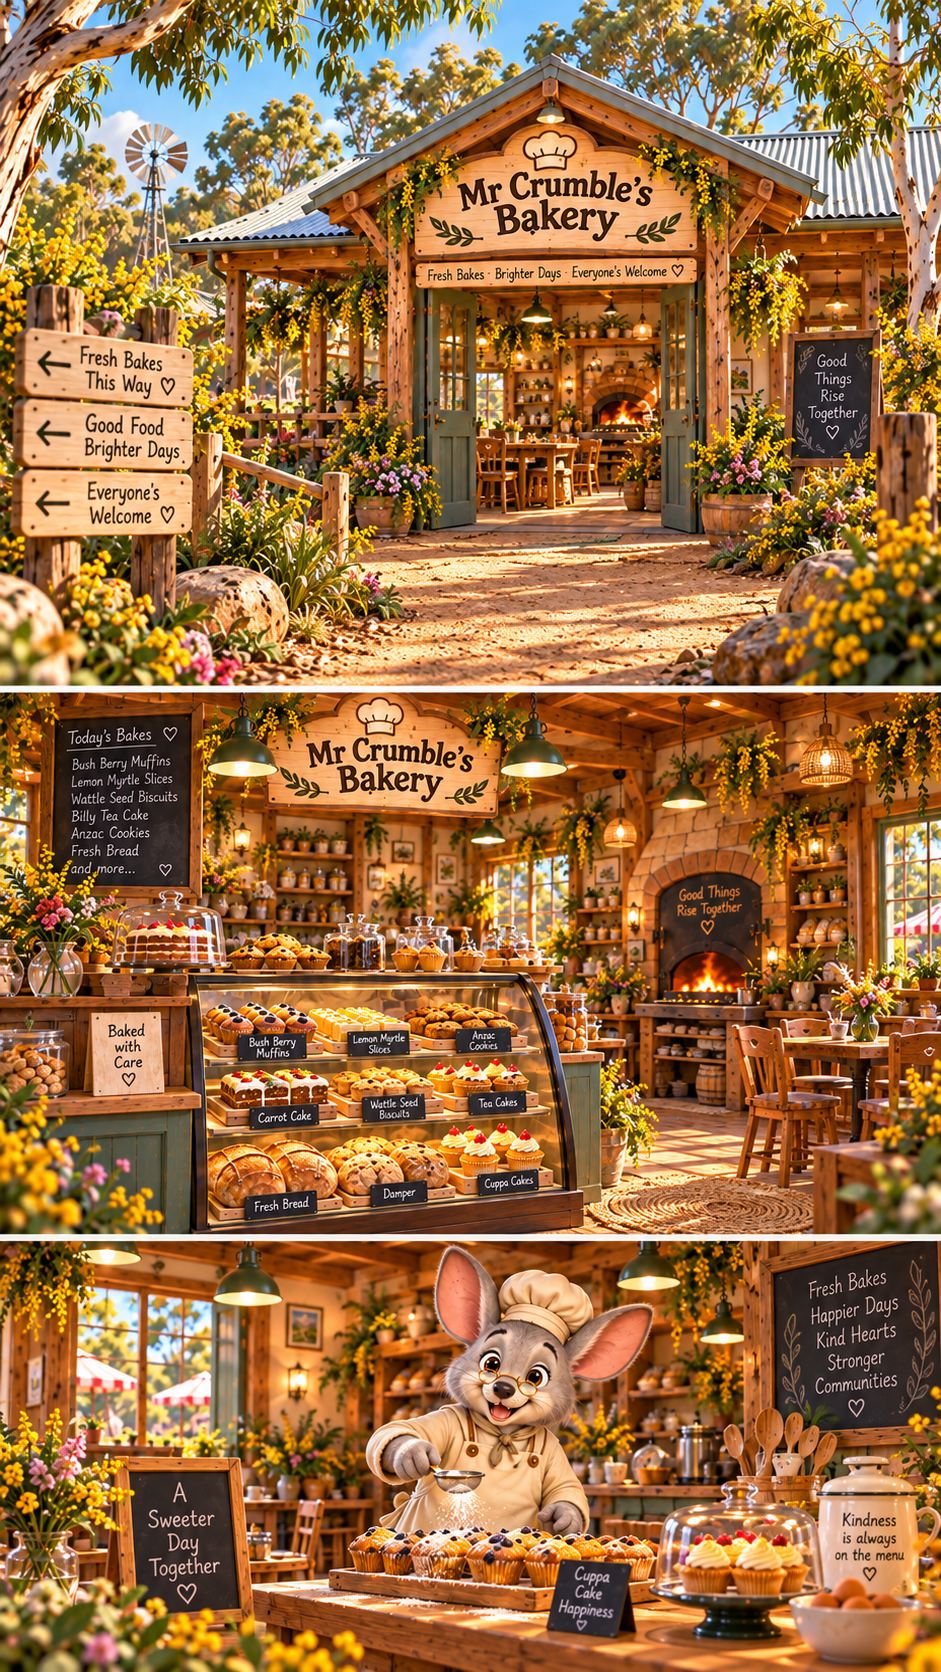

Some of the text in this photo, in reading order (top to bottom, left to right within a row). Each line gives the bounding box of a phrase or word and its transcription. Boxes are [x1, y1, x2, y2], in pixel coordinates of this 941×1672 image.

[457, 170, 653, 211] Mr Crumble's
[494, 199, 620, 241] Bakery
[428, 265, 667, 282] Fresh Bakes Brighter Days Everyone's Welcome
[80, 346, 162, 372] Fresh Bakes
[817, 353, 847, 368] Good
[86, 370, 152, 400] This Way
[814, 372, 852, 388] Things
[821, 389, 844, 402] Rise
[808, 406, 858, 424] Together
[86, 413, 164, 436] Good Food
[84, 438, 180, 464] Brighter Days
[88, 481, 160, 506] Everyone's
[90, 506, 152, 524] Welcome
[68, 727, 152, 748] Today's Bakes
[72, 754, 171, 772] Bush Berry Muffins
[306, 737, 474, 772] Mr Crumble's
[72, 772, 173, 790] Lemon Myrtle Slices
[336, 762, 444, 802] Bakery
[71, 790, 178, 804] Wattle Seed Biscuits
[71, 808, 149, 825] Billy Tea Cake
[70, 826, 150, 840] Anzac Cookies
[71, 844, 139, 856] Fresh Bread
[70, 862, 136, 874] and more...
[679, 884, 740, 902] Good Things
[677, 901, 742, 918] Rise Together
[108, 1023, 145, 1038] Baked
[353, 1035, 378, 1044] Lemon
[114, 1039, 142, 1052] with
[249, 1036, 296, 1049] Bush Berry
[469, 1040, 498, 1050] Cookies
[114, 1056, 142, 1068] Care
[256, 1048, 290, 1059] Muffins
[370, 1097, 418, 1109] Wattle Seed
[478, 1096, 518, 1108] Tea Cakes
[258, 1109, 312, 1124] Carrot Cake
[484, 1174, 534, 1192] Cuppa Cakes
[254, 1196, 310, 1212] Fresh Bread
[384, 1188, 416, 1202] Damper
[808, 1269, 887, 1300] Fresh Bakes
[811, 1296, 899, 1328] Happier Days
[816, 1322, 897, 1350] Kind Hearts
[828, 1352, 886, 1372] Stronger
[815, 1372, 898, 1395] Communities
[173, 1482, 187, 1503] A
[148, 1509, 215, 1528] Sweeter
[842, 1512, 896, 1527] Kindness
[167, 1532, 199, 1556] Day
[842, 1530, 896, 1548] is always
[834, 1548, 904, 1561] on the menu
[148, 1557, 220, 1582] Together
[574, 1566, 610, 1587] Cuppa
[575, 1584, 602, 1600] Cake
[558, 1599, 614, 1619] Happiness
